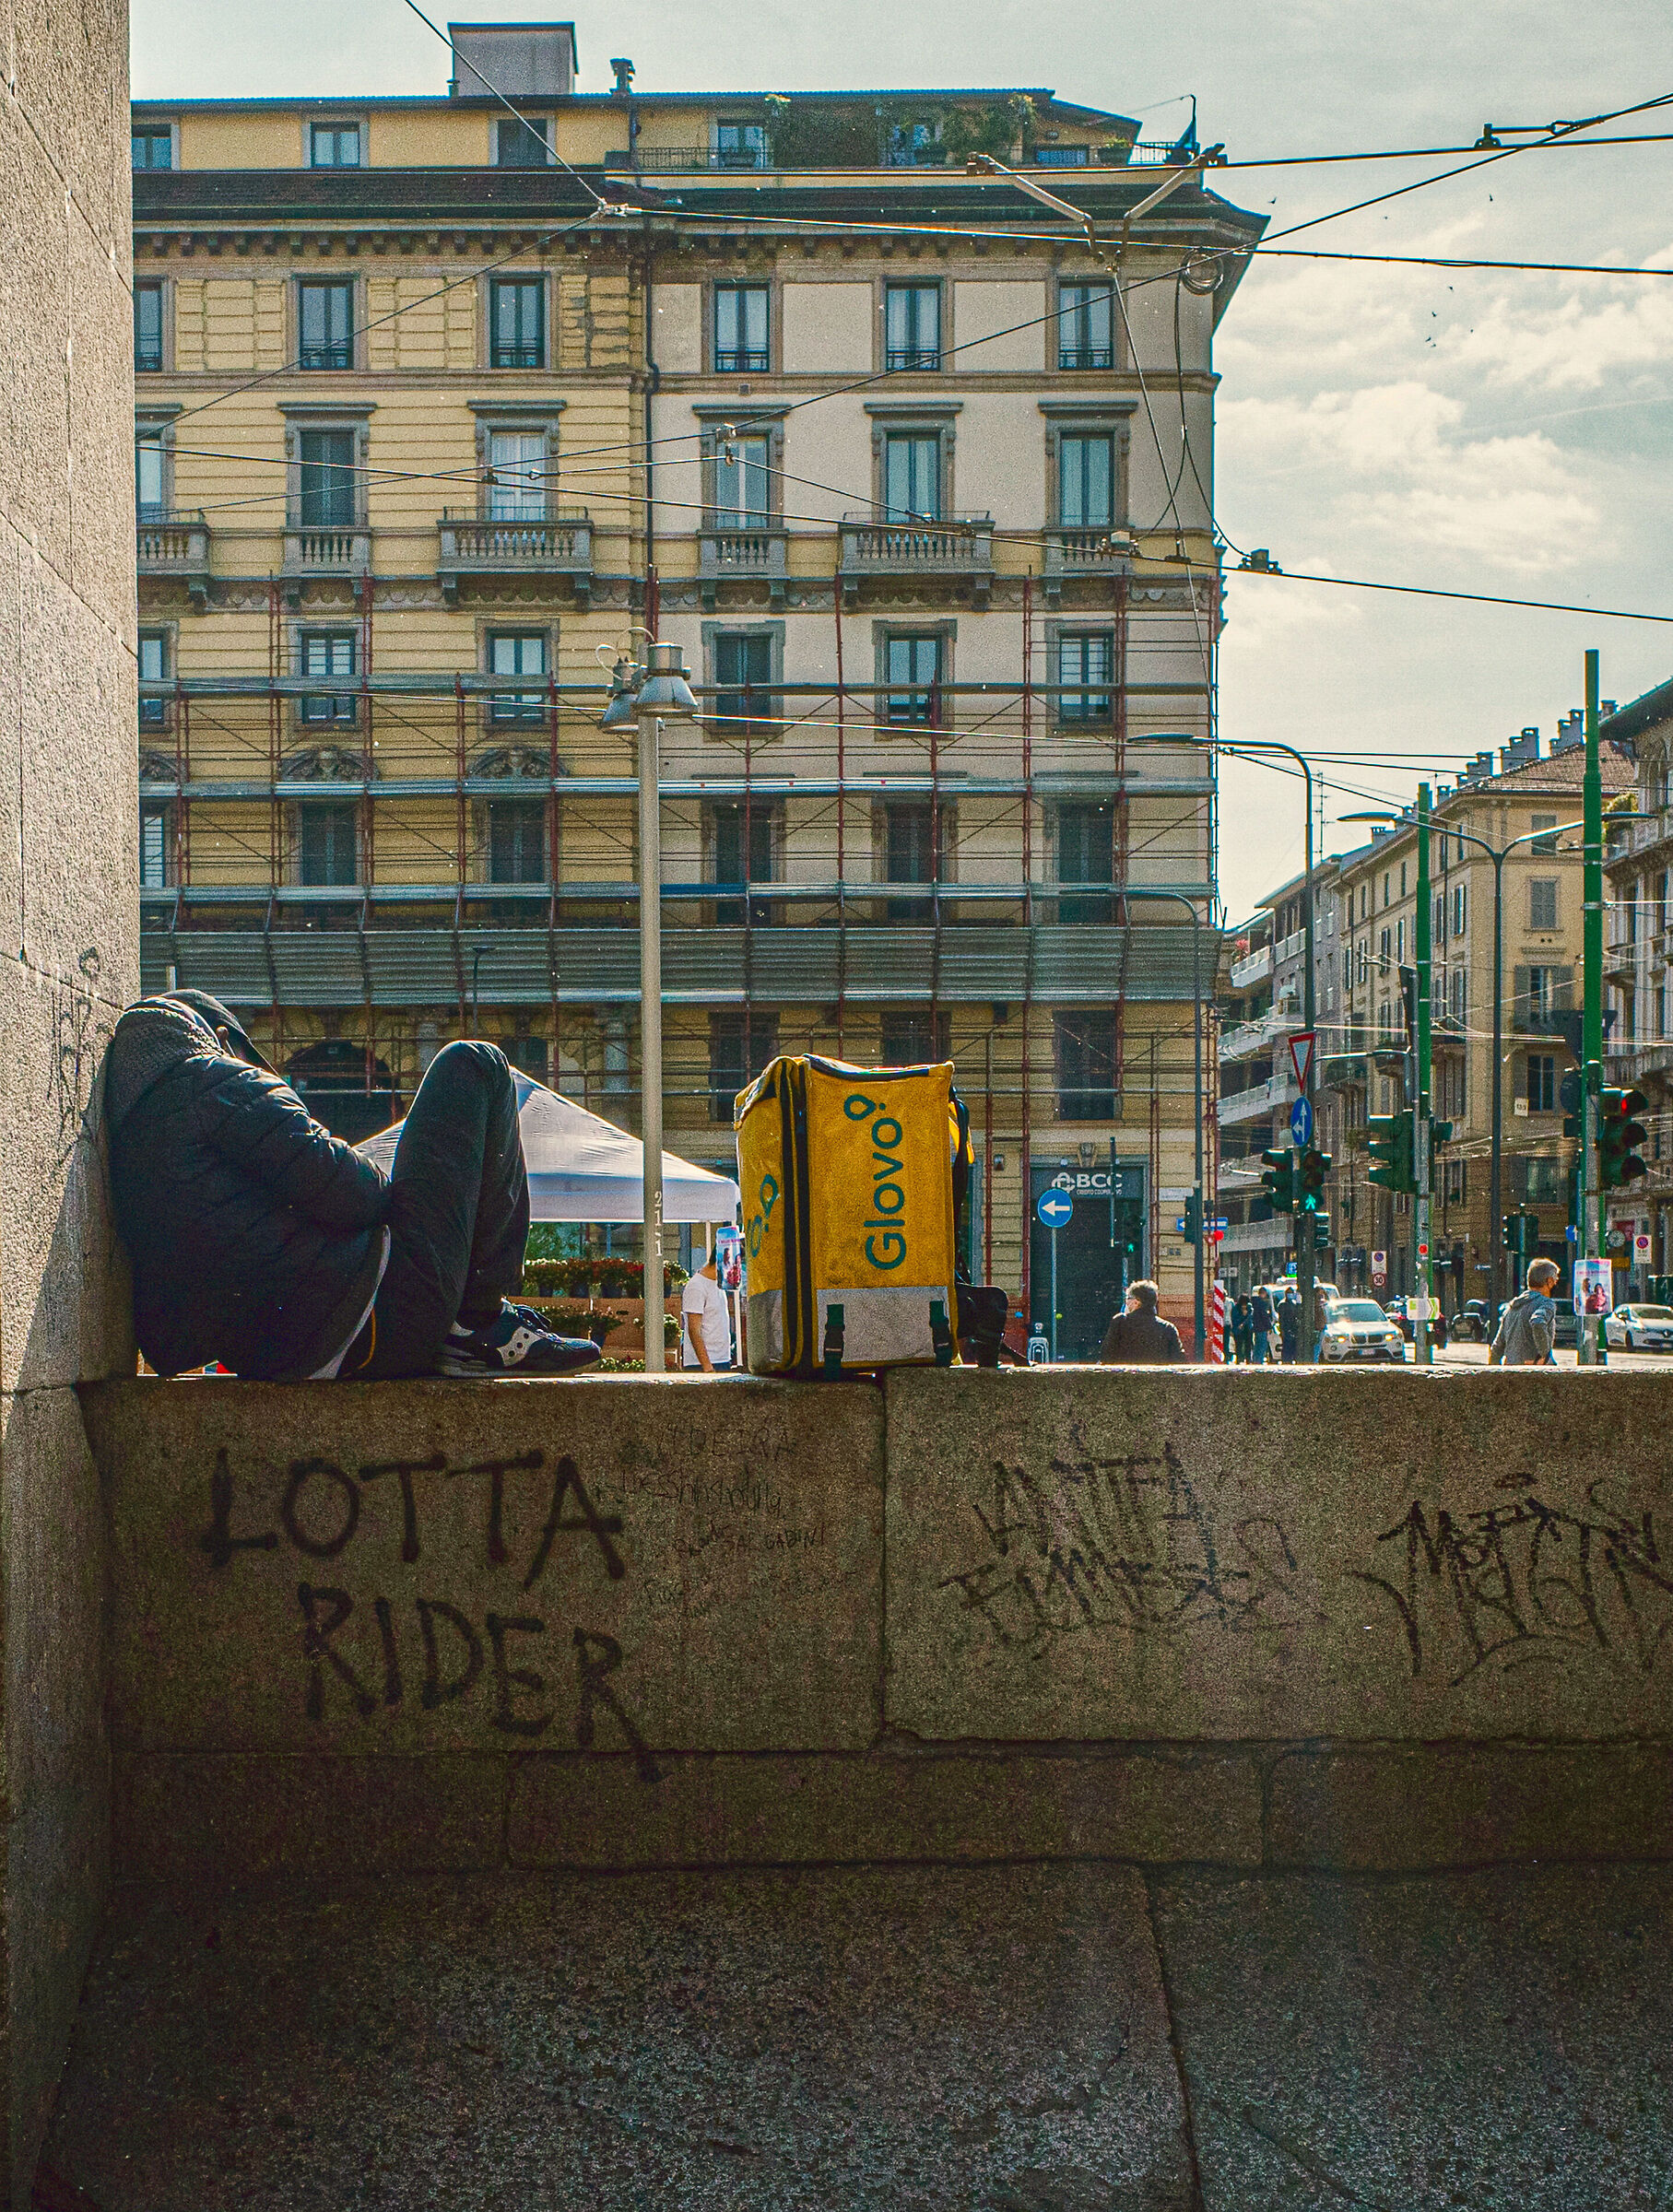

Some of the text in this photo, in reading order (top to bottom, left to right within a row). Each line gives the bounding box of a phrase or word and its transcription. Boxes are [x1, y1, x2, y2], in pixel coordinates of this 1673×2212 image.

[864, 1117, 907, 1270] Glovo
[1077, 1173, 1123, 1188] BCC
[200, 1447, 624, 1587] LOTTA
[298, 1581, 664, 1783] RIDER
